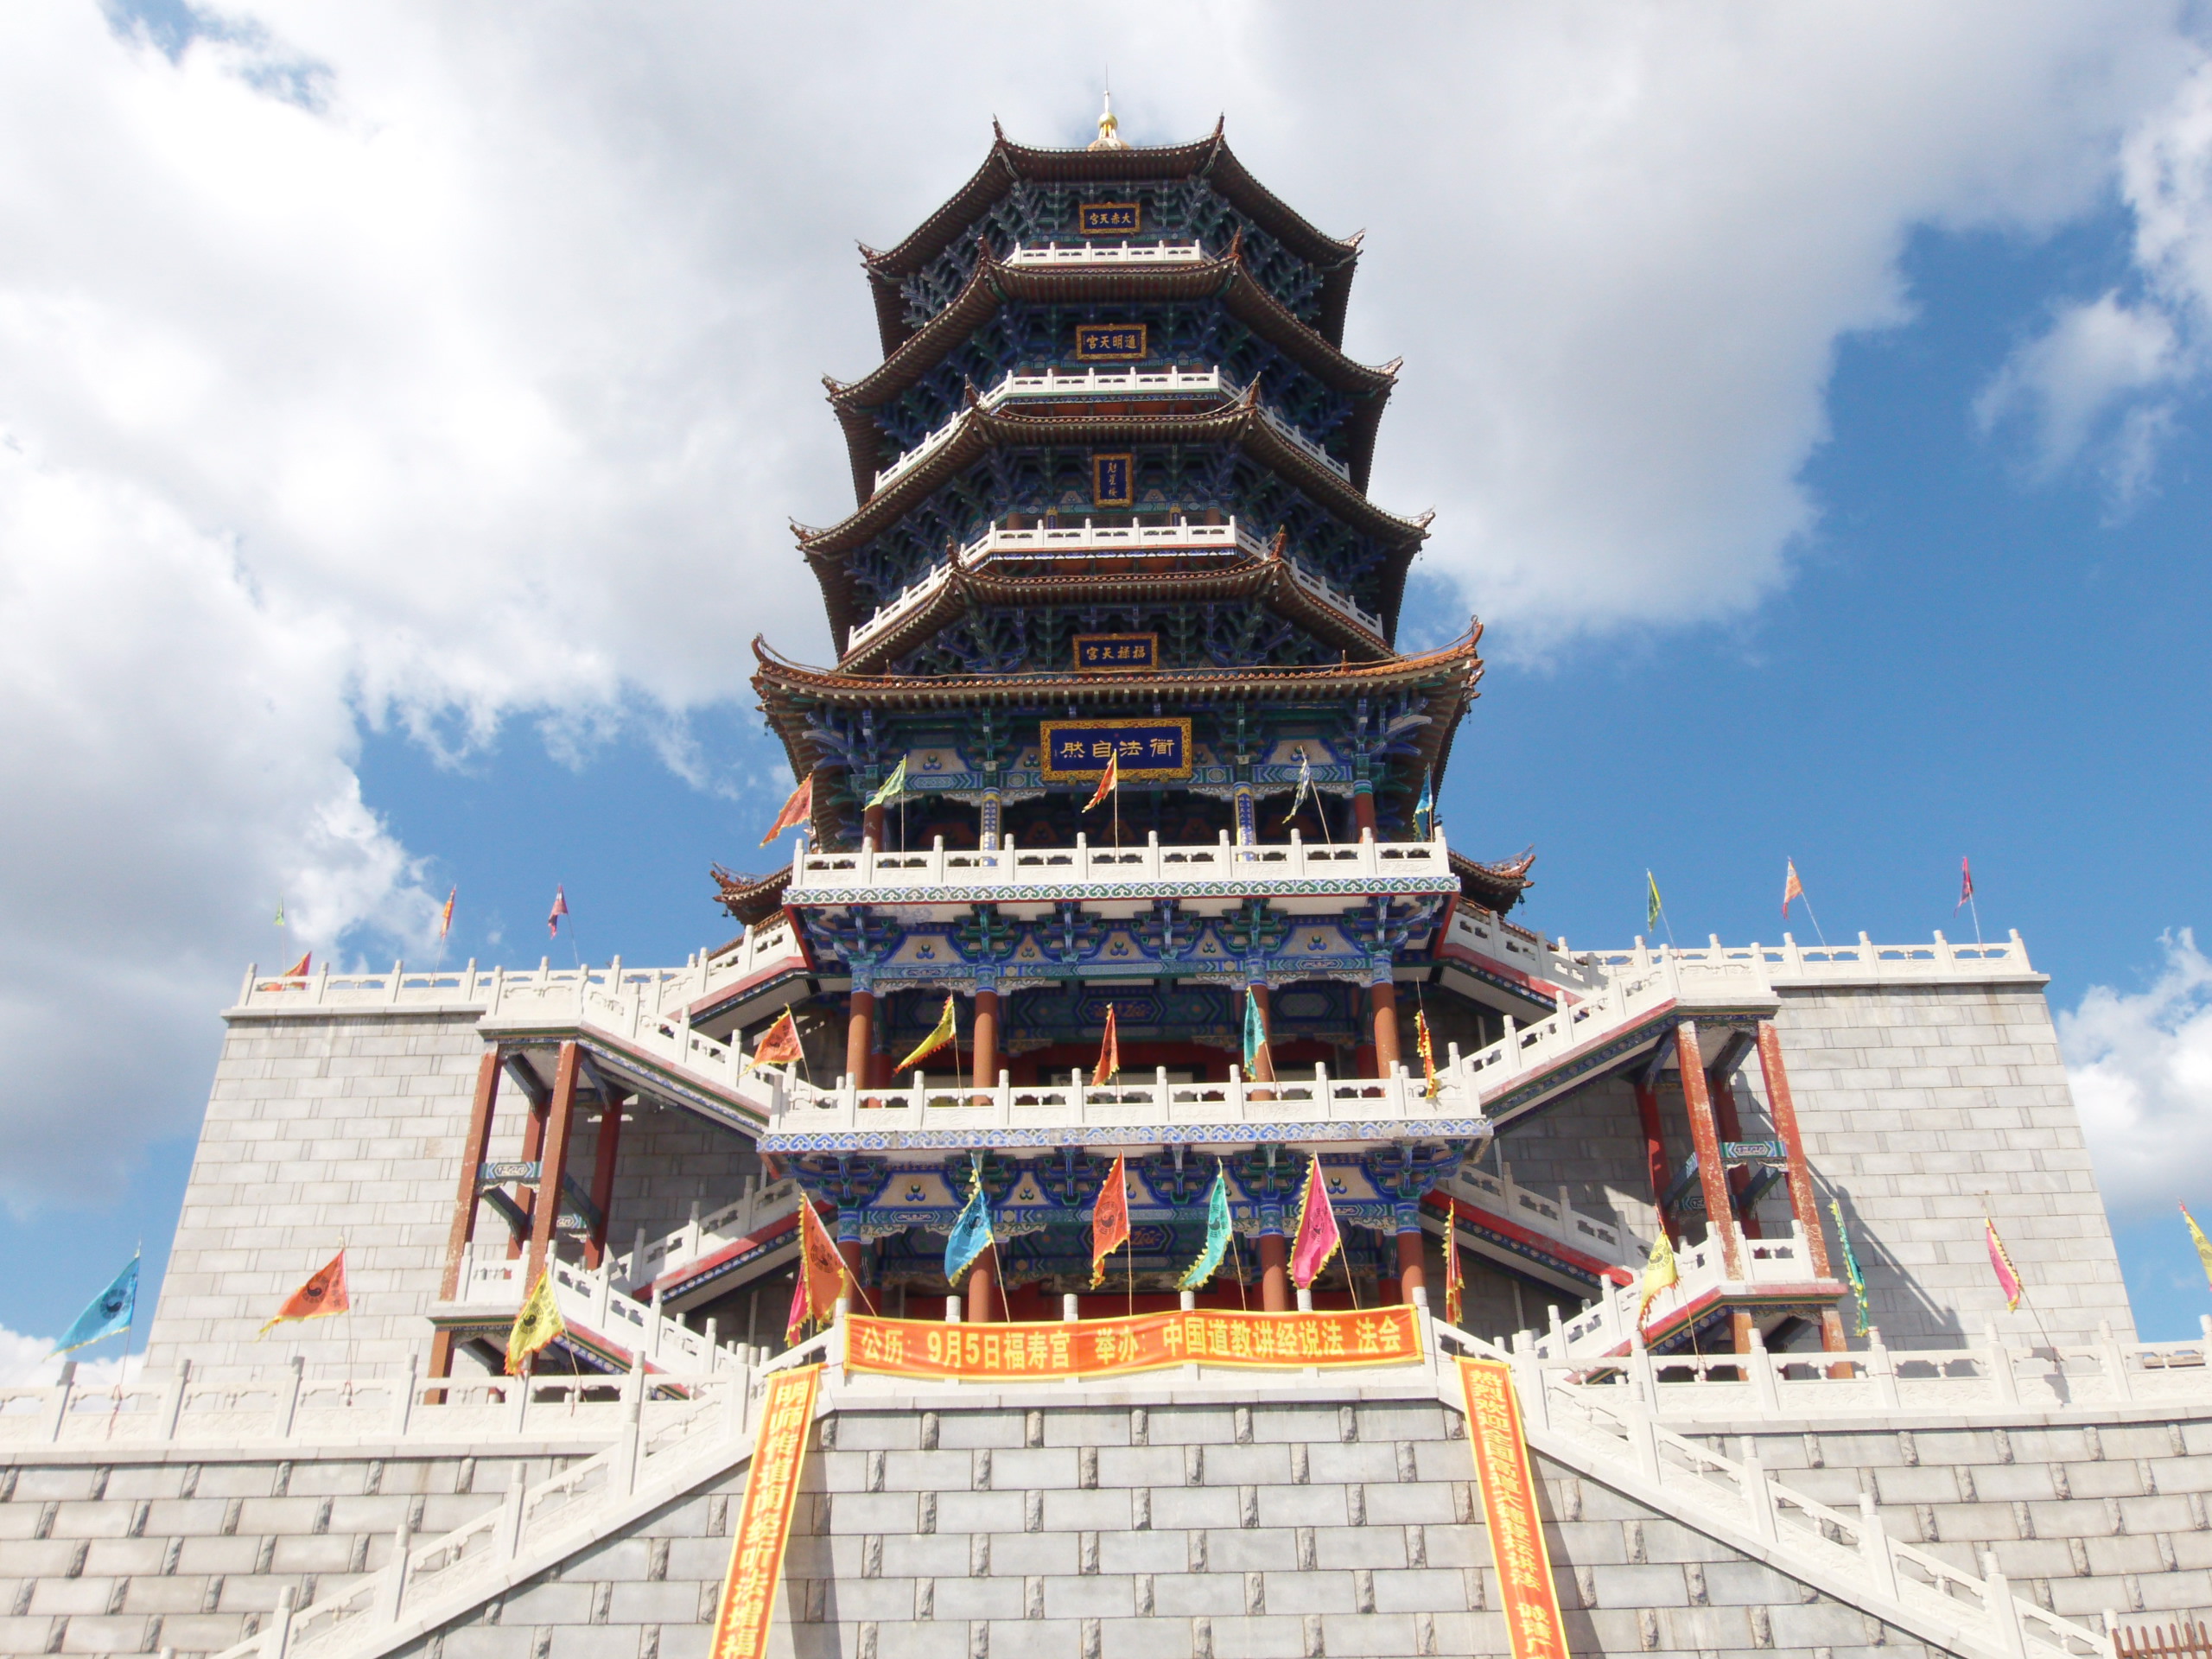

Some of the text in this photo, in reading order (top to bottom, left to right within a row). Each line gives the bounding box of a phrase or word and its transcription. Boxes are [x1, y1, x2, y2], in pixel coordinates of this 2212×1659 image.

[1163, 1316, 1344, 1359] 中国道教讲经说法
[1355, 1314, 1402, 1354] 法会
